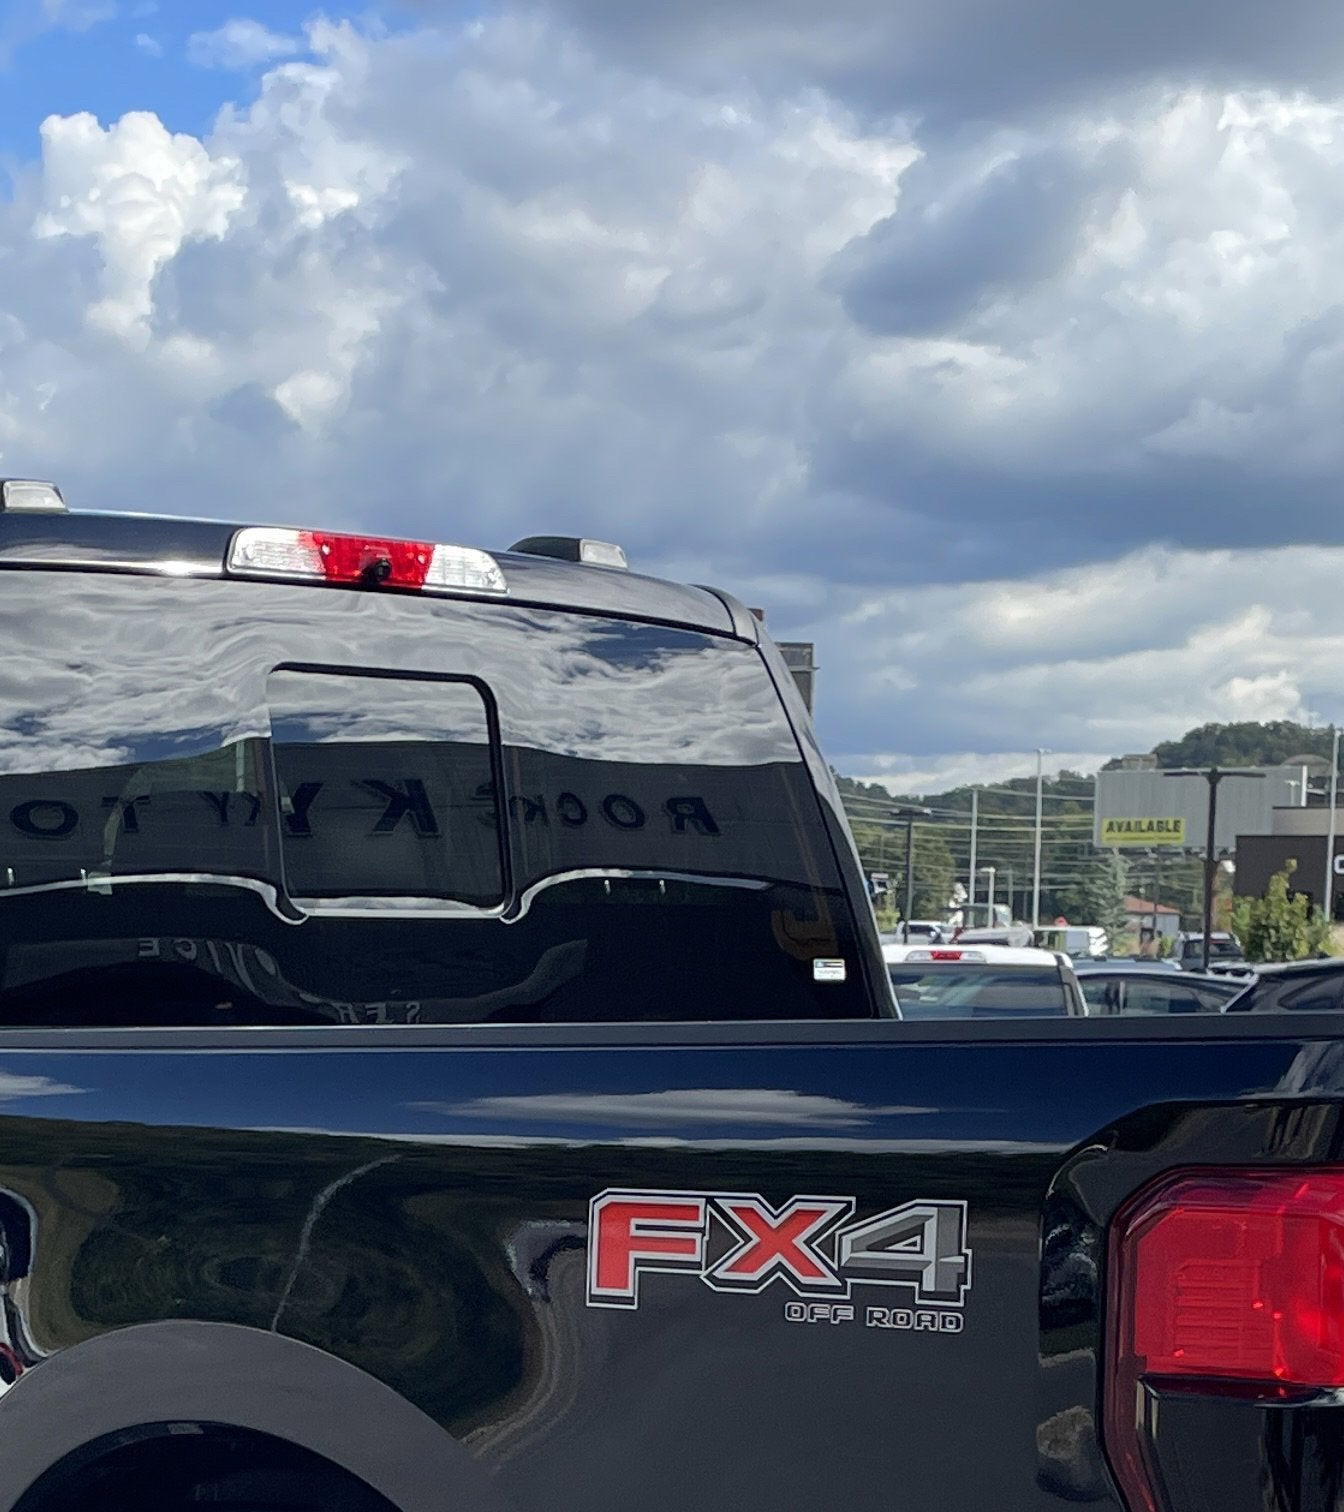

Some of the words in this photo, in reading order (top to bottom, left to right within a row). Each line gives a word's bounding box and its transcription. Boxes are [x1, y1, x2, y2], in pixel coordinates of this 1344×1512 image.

[1106, 820, 1181, 833] AVAILABLE
[586, 1188, 972, 1309] FX4
[785, 1302, 855, 1325] OFF
[866, 1307, 965, 1333] ROAD
